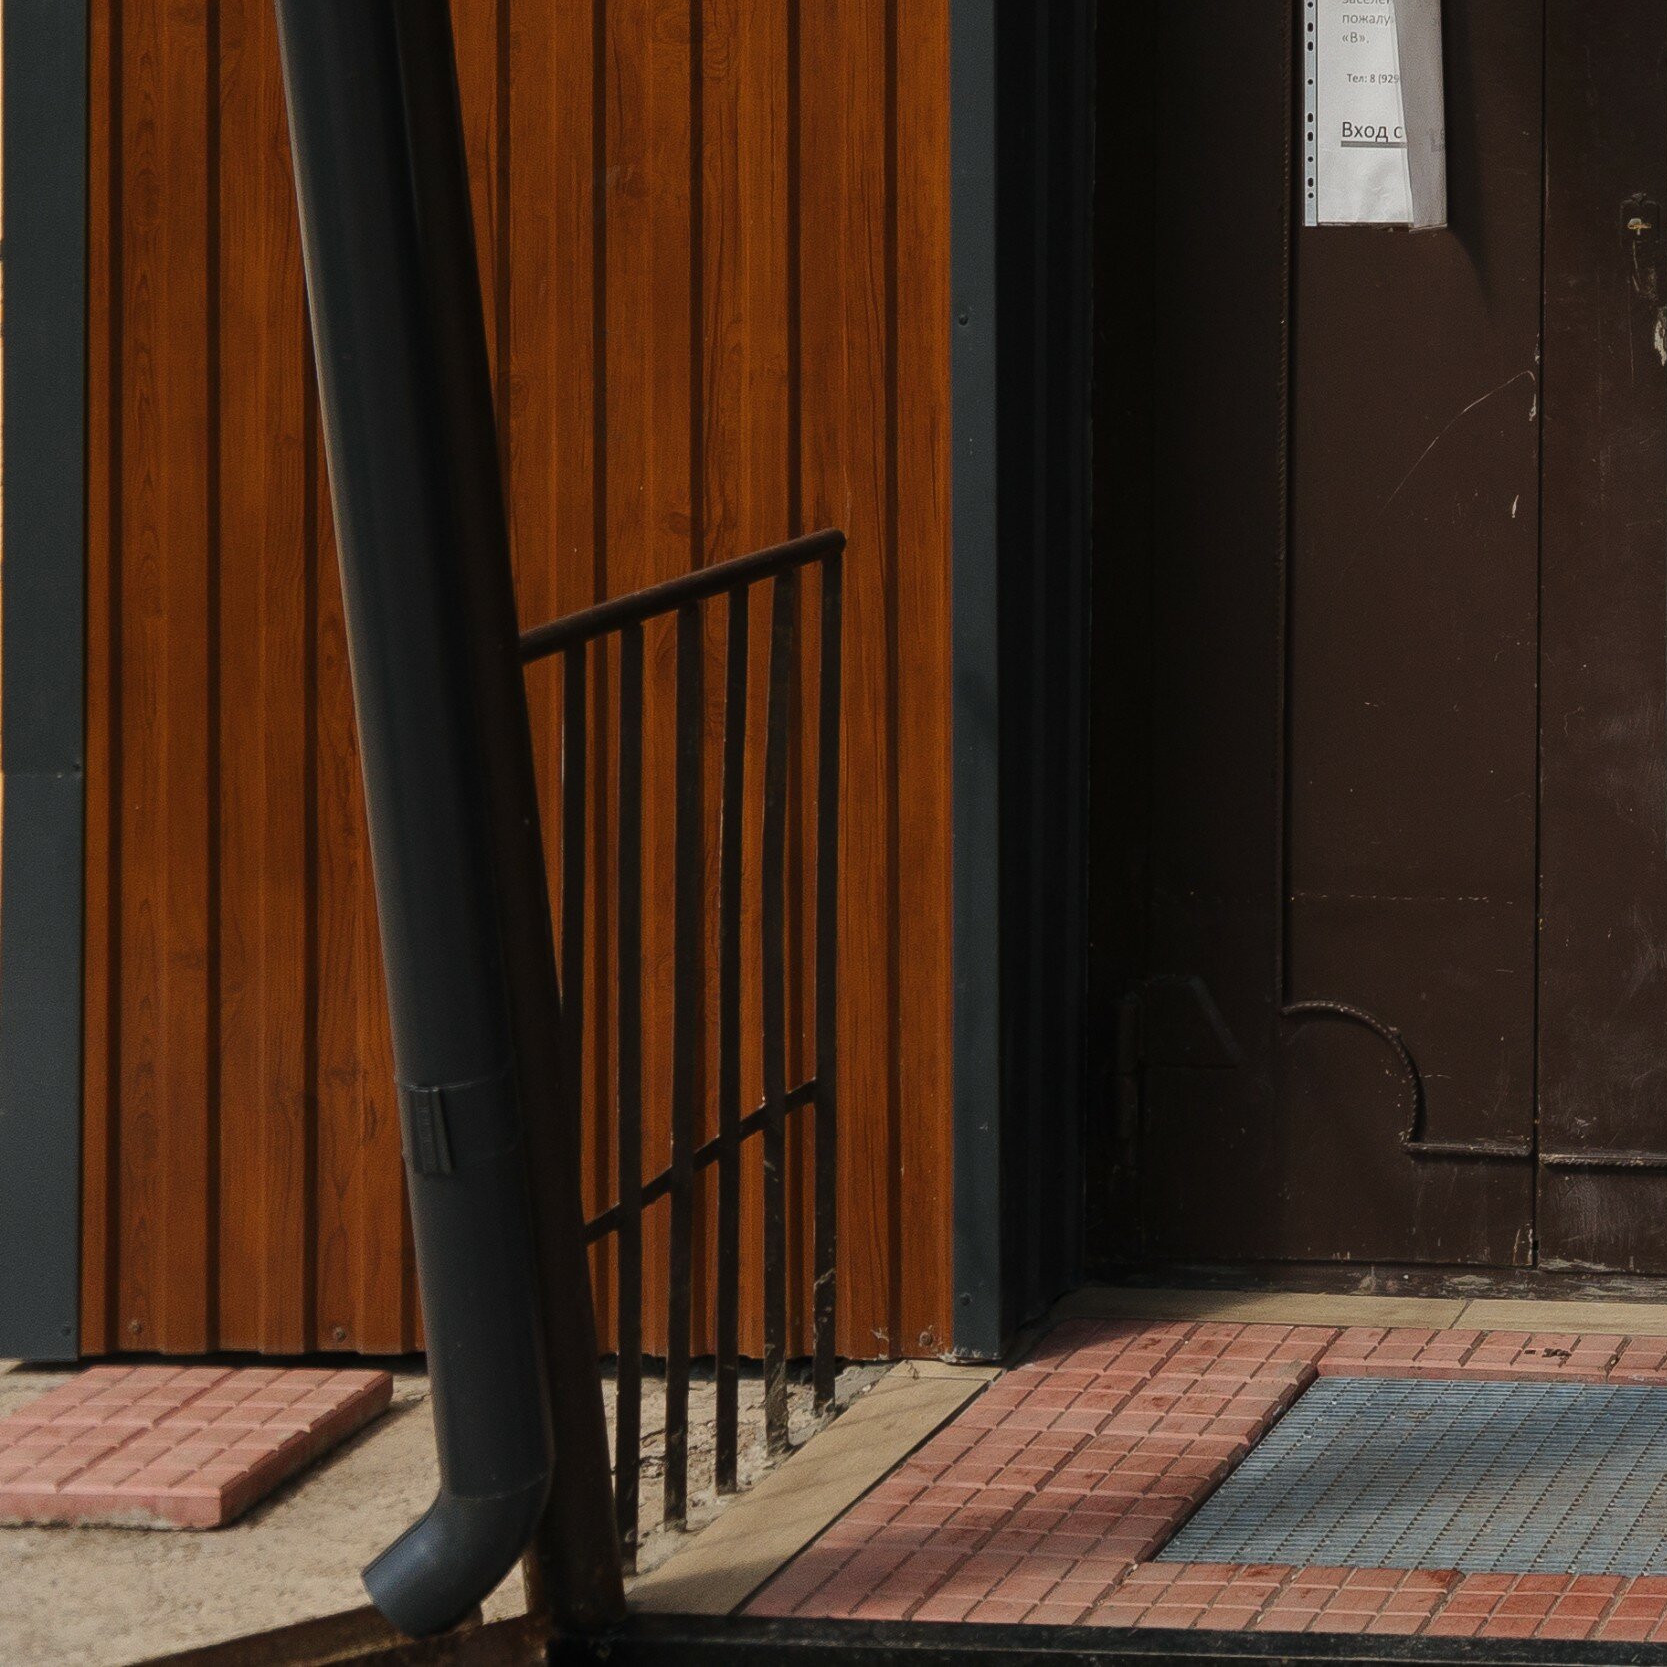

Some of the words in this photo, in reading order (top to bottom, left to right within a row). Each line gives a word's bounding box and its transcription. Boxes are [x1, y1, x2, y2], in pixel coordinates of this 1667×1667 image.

[1346, 73, 1368, 83] Тел:
[1369, 73, 1376, 83] 8
[1342, 121, 1389, 142] Вход
